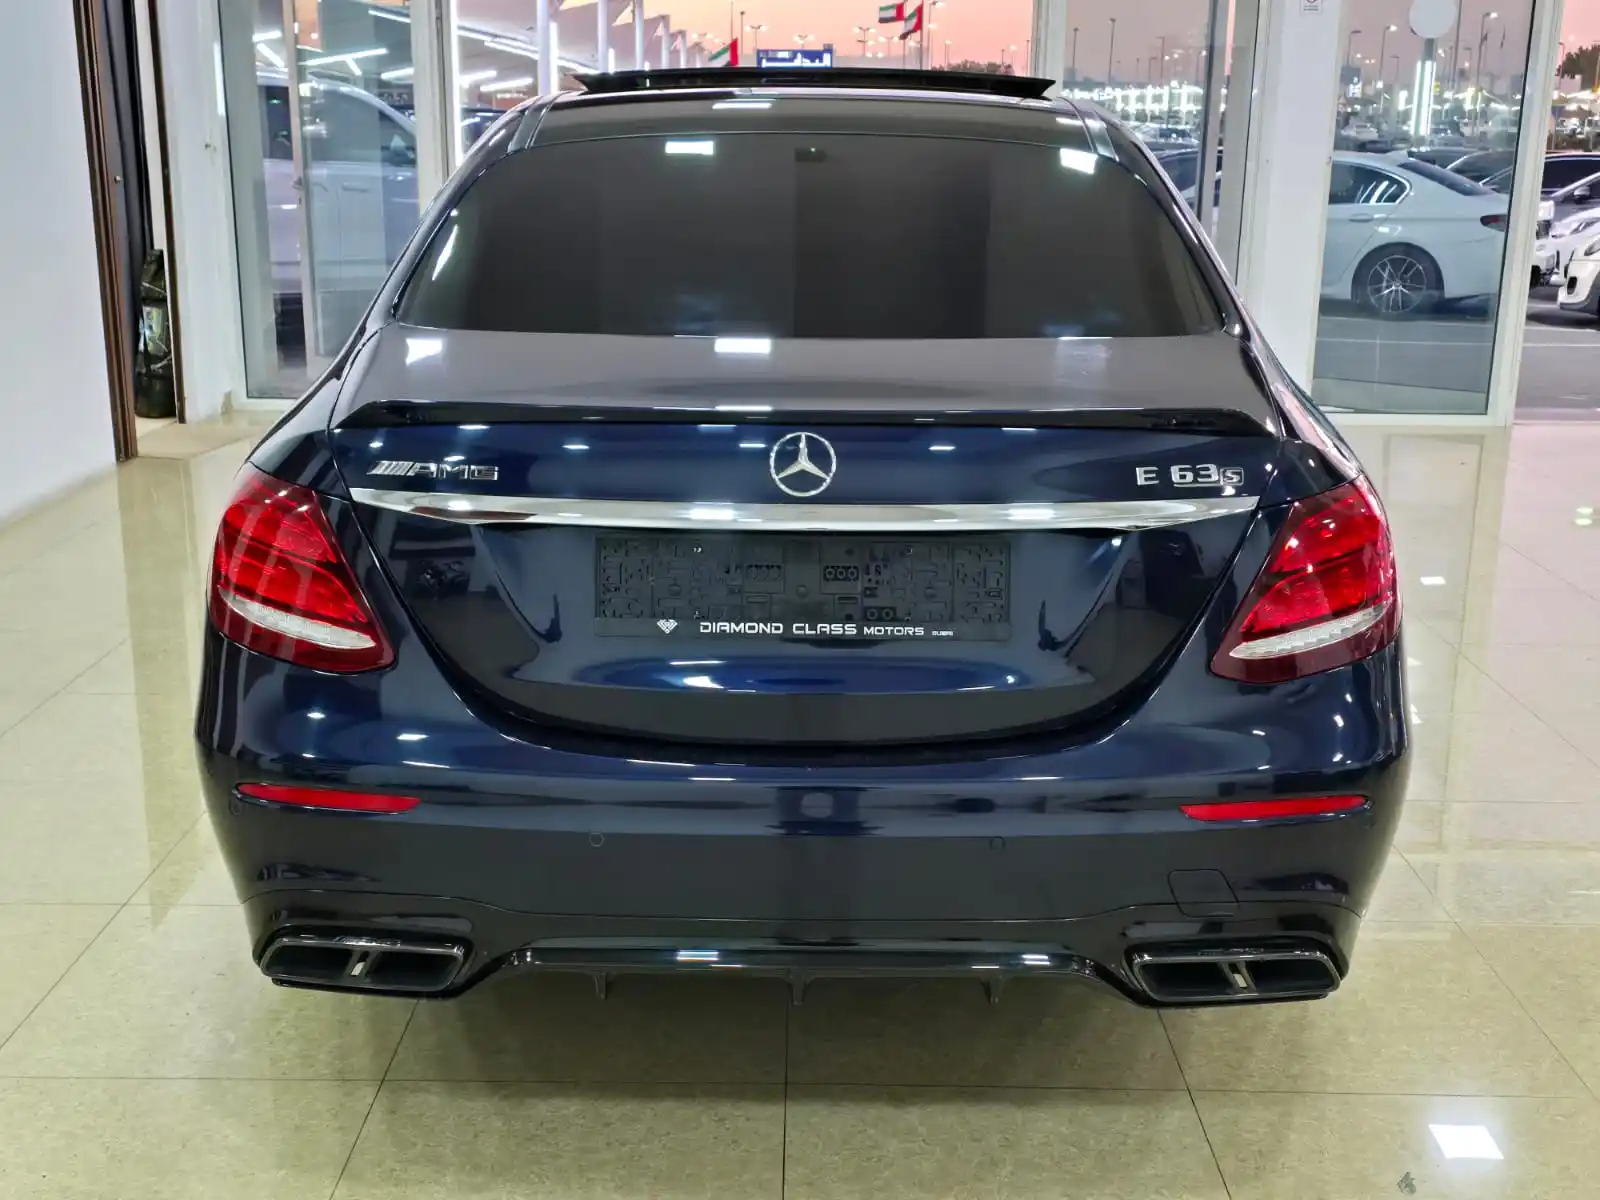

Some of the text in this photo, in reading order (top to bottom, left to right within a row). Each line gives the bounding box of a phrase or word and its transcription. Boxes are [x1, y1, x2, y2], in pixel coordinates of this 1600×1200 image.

[1135, 466, 1160, 486] E
[699, 621, 784, 634] DIAMOND
[792, 623, 858, 635] CLASS
[863, 626, 925, 636] MOTORS
